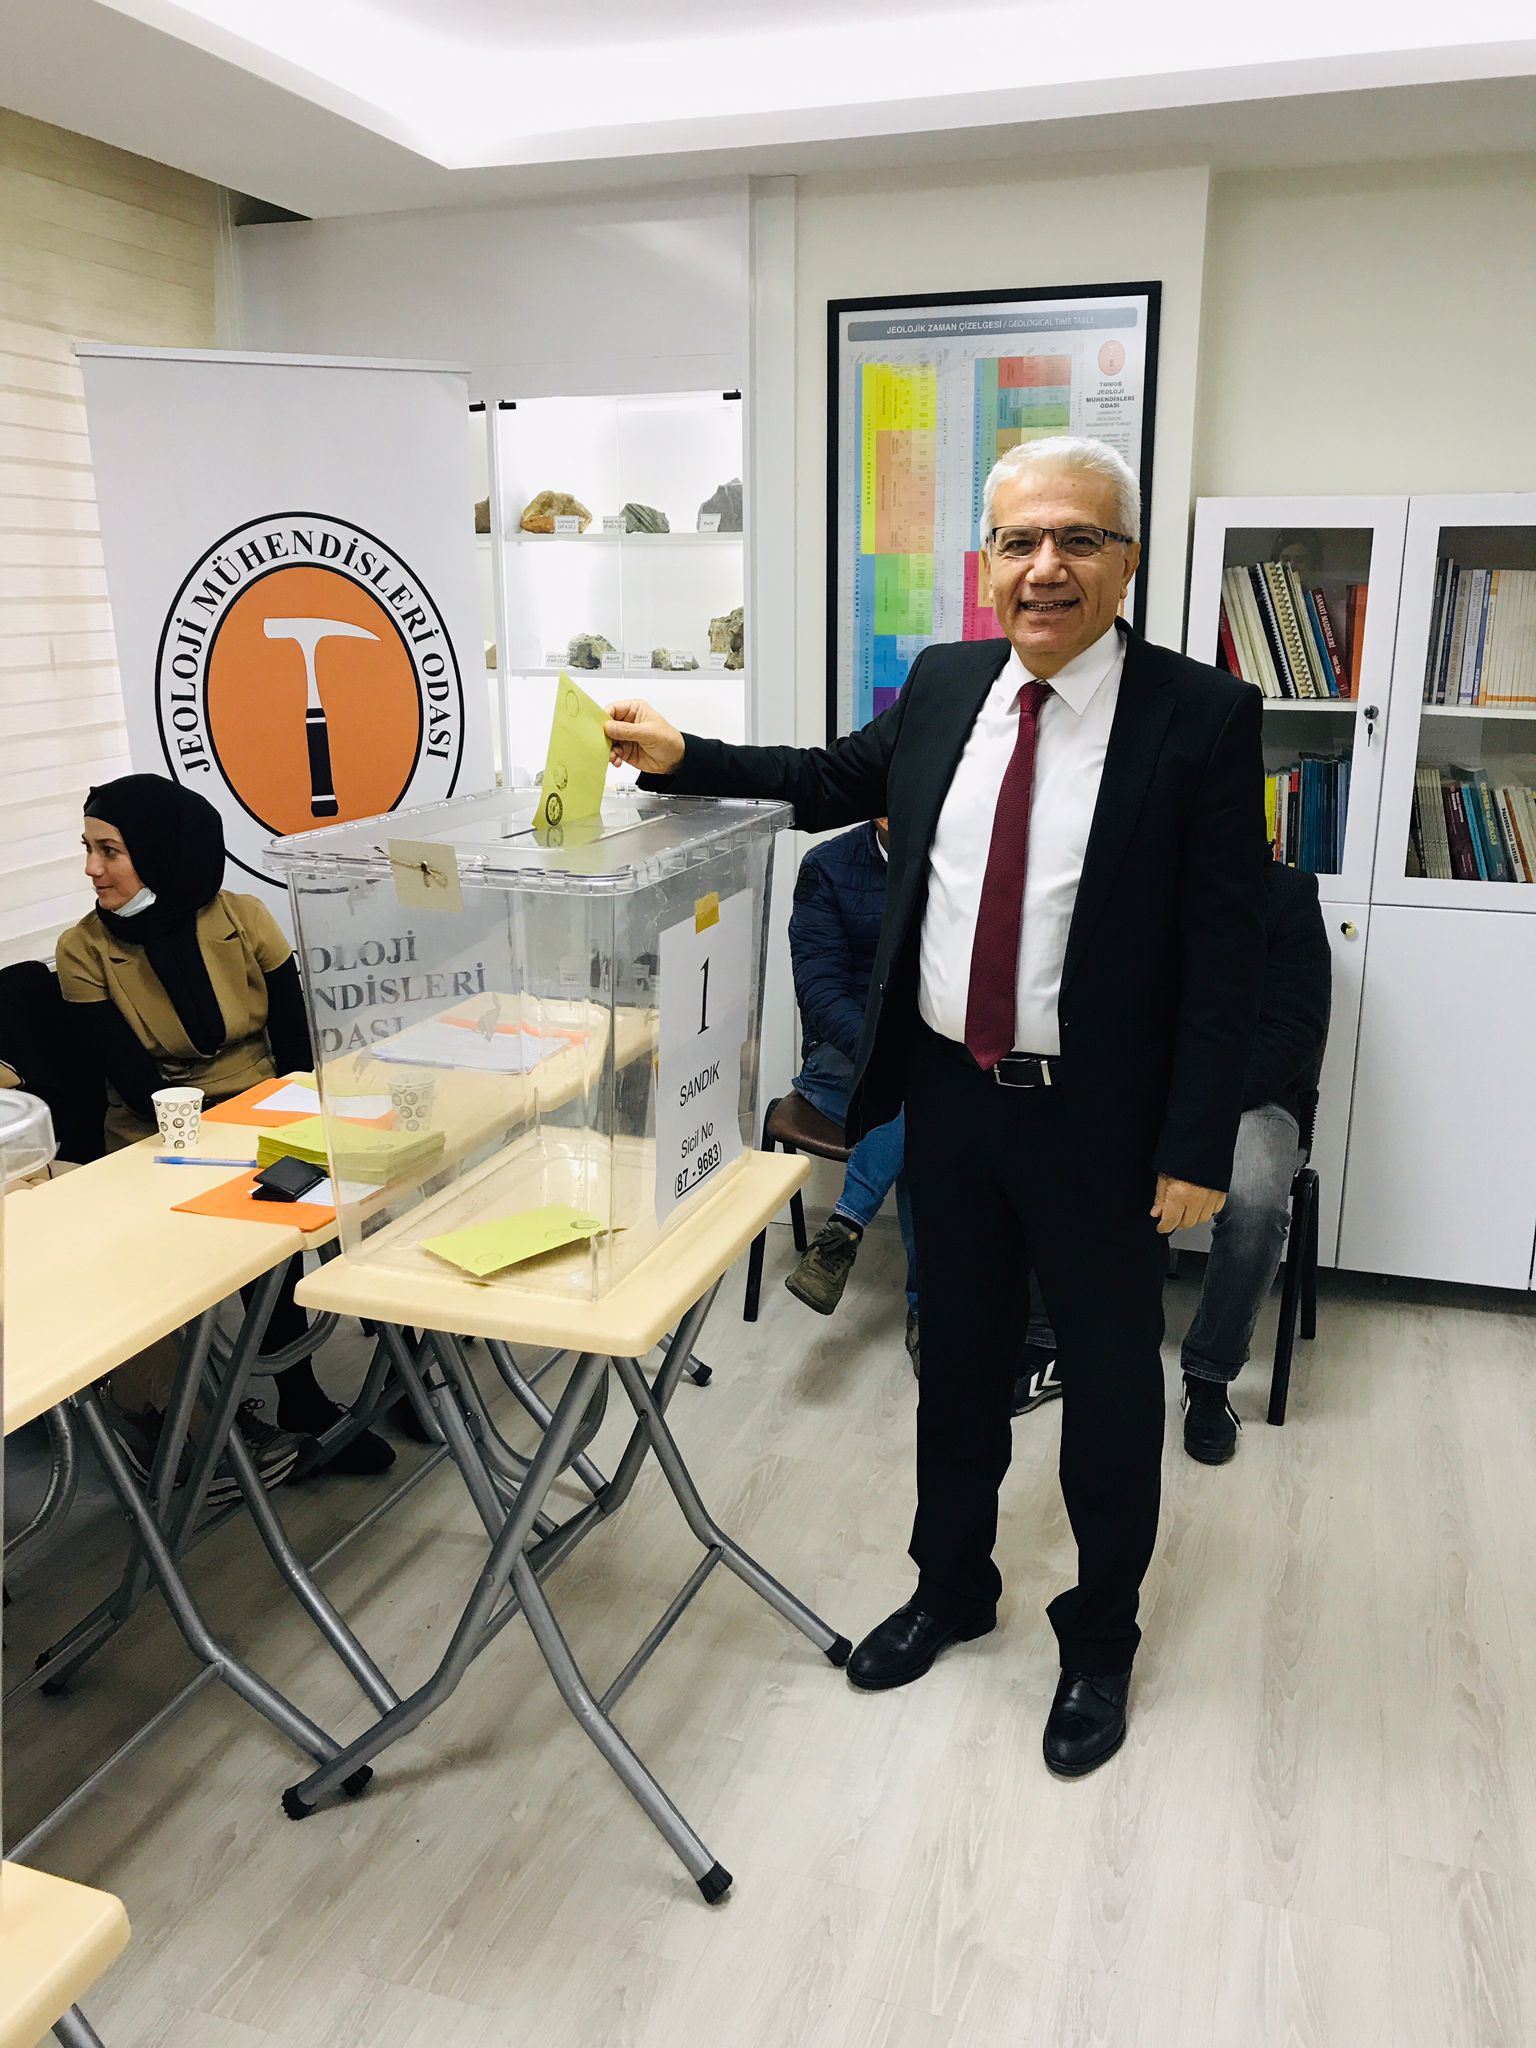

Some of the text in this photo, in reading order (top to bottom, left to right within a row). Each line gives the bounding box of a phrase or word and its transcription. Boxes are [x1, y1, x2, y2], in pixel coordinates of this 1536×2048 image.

[886, 324, 926, 335] JEOLOJİK
[927, 322, 957, 332] ZAMAN
[958, 319, 1002, 332] ÇİZELGESİ
[1008, 318, 1053, 329] GEOLOGICAL
[1054, 317, 1071, 326] TIME
[1073, 315, 1095, 325] TABLE
[1085, 395, 1135, 403] MÜHENDİSLERİ
[170, 529, 455, 774] JEOLOJİ MÜHENDİSLERİ ODASI
[312, 929, 419, 974] OLOJİ
[313, 962, 486, 1013] NDİSLERİ
[697, 956, 711, 1035] 1
[320, 1016, 405, 1053] DASI
[679, 1059, 721, 1107] SANDIK
[681, 1120, 714, 1159] Sicil No
[674, 1165, 690, 1199] (87
[698, 1140, 722, 1178] 9683)
